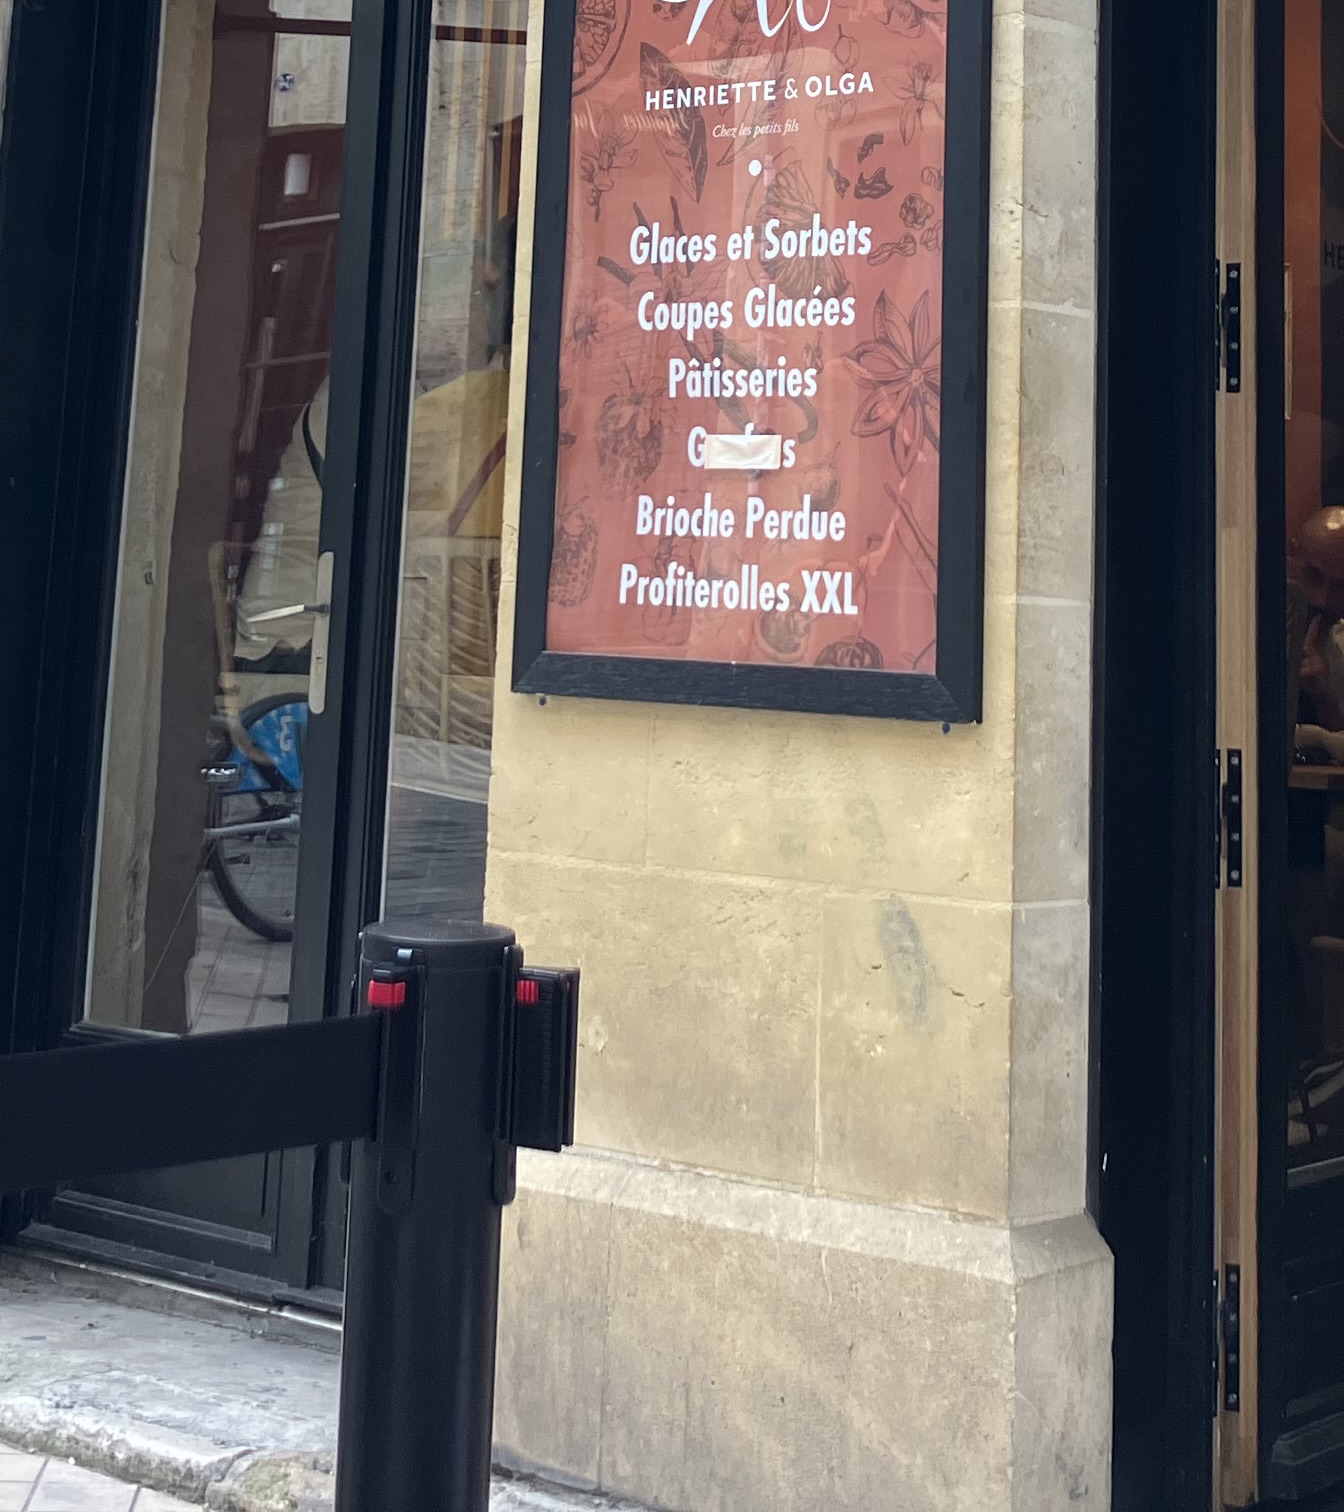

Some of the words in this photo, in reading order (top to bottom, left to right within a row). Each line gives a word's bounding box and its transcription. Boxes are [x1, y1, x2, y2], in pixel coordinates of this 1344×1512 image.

[645, 80, 776, 111] HENRIETTE
[784, 78, 799, 99] &
[805, 71, 874, 98] OLGA
[712, 124, 737, 139] Chez
[739, 122, 753, 137] les
[753, 119, 782, 140] petits
[782, 118, 800, 135] fils
[629, 221, 717, 265] Glaces
[727, 225, 755, 260] et
[764, 213, 872, 259] Sorbets
[637, 291, 734, 341] Coupes
[744, 283, 855, 328] Glacées
[668, 356, 817, 398] Pâtisseries
[636, 492, 735, 538] Brioche
[745, 494, 846, 541] Perdue
[618, 561, 790, 612] Profiterolles
[800, 569, 859, 615] XXL
